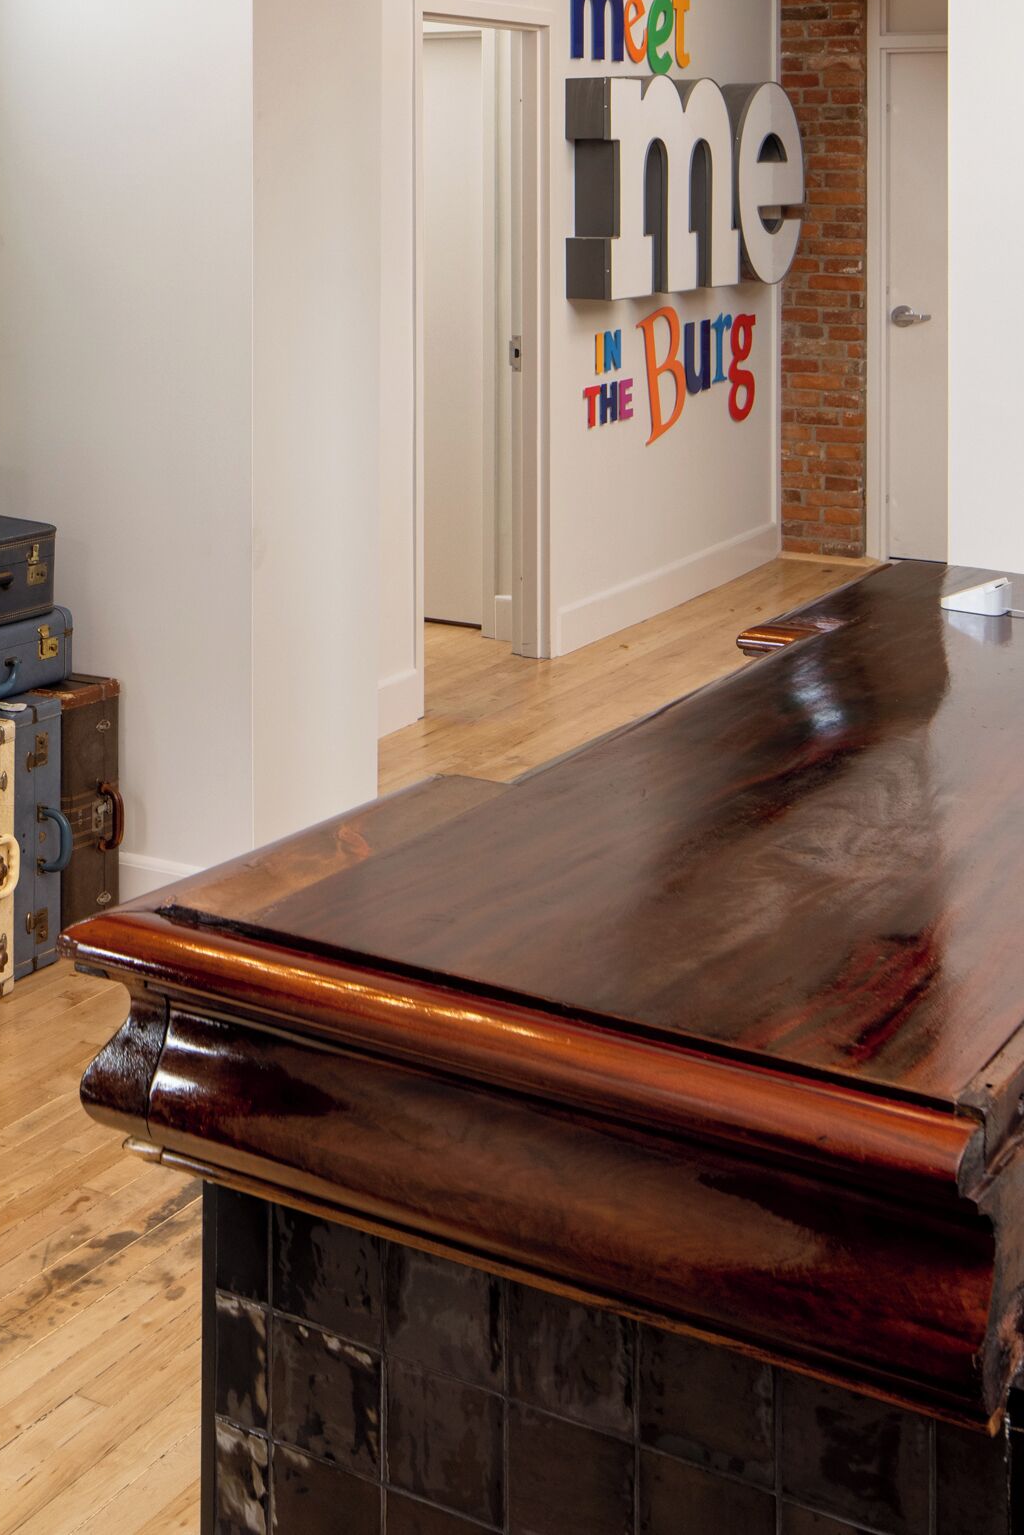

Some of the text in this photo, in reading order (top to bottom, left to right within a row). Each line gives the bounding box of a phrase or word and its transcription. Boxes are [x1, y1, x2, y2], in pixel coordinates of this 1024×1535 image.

[565, 75, 805, 300] me
[595, 329, 622, 375] IN
[636, 306, 756, 447] Burg
[583, 378, 634, 430] THE
